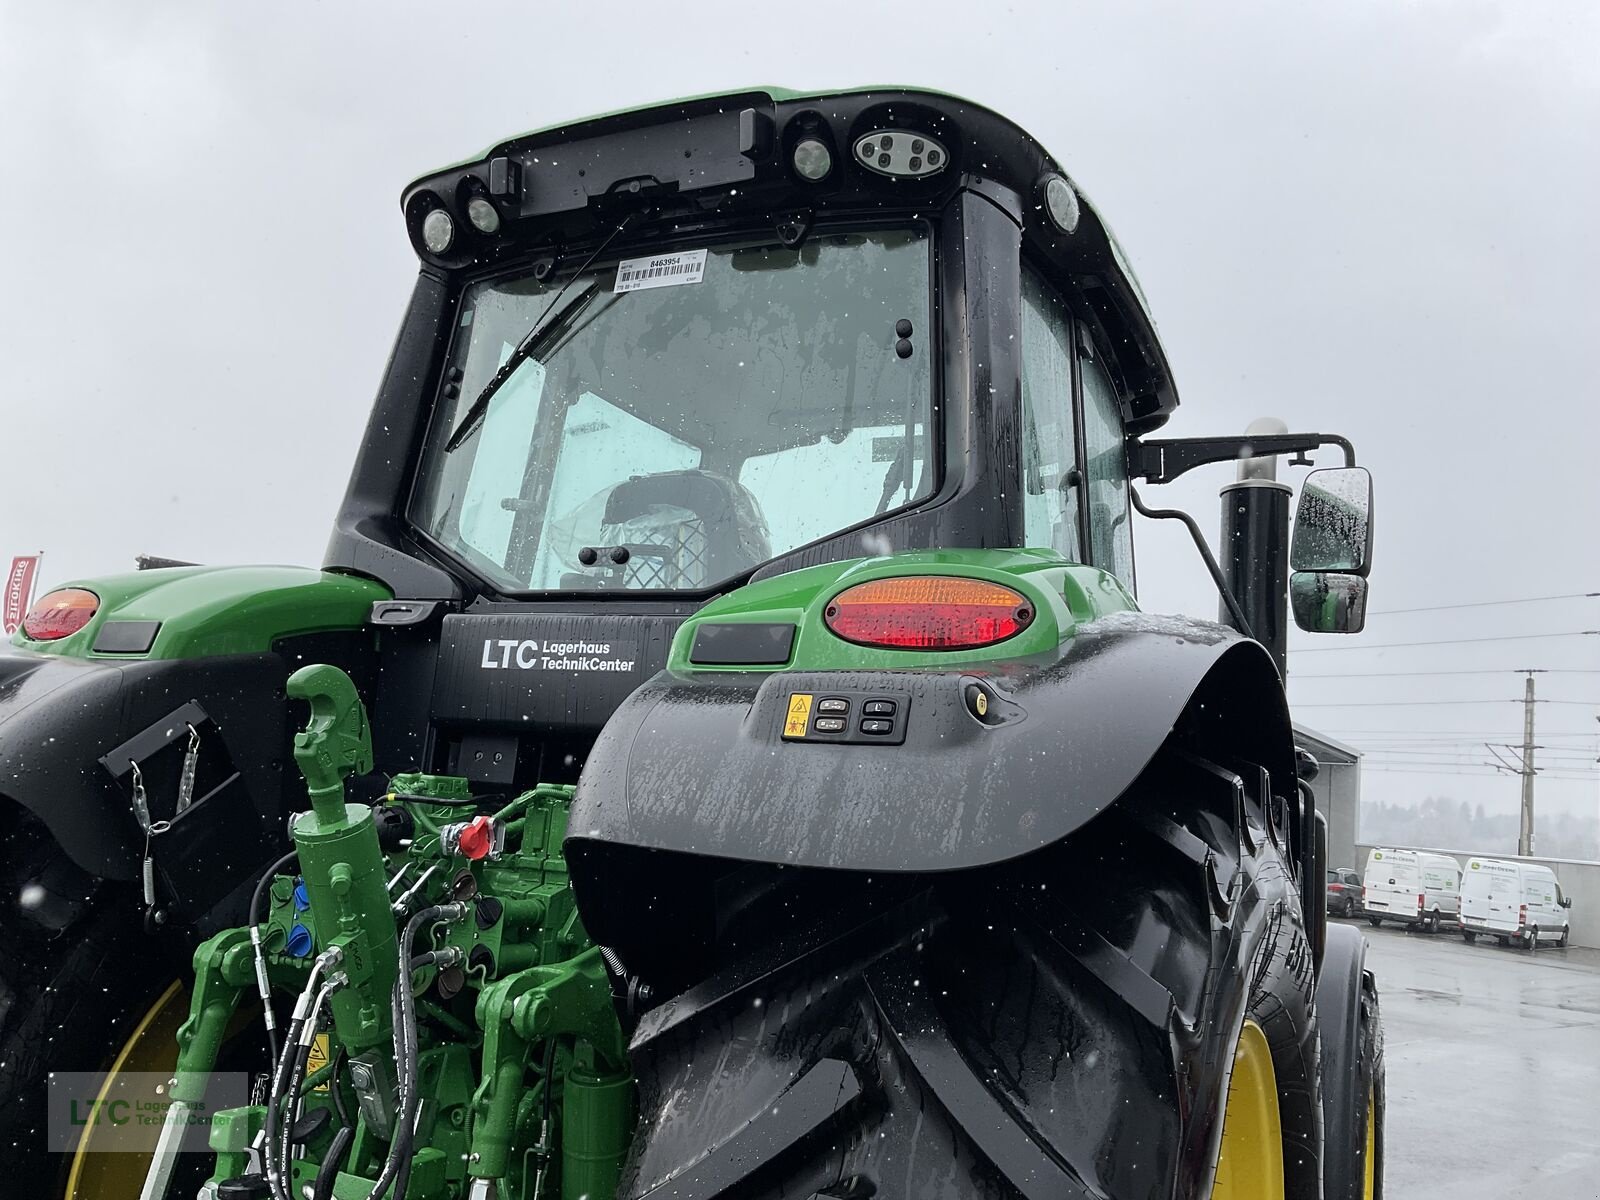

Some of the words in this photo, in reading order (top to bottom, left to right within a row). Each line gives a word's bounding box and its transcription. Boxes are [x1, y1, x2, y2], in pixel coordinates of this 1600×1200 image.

[650, 257, 681, 268] 8463954
[481, 639, 538, 669] LTC
[542, 640, 611, 656] Lagerhaus
[541, 656, 635, 672] TechnikCenter
